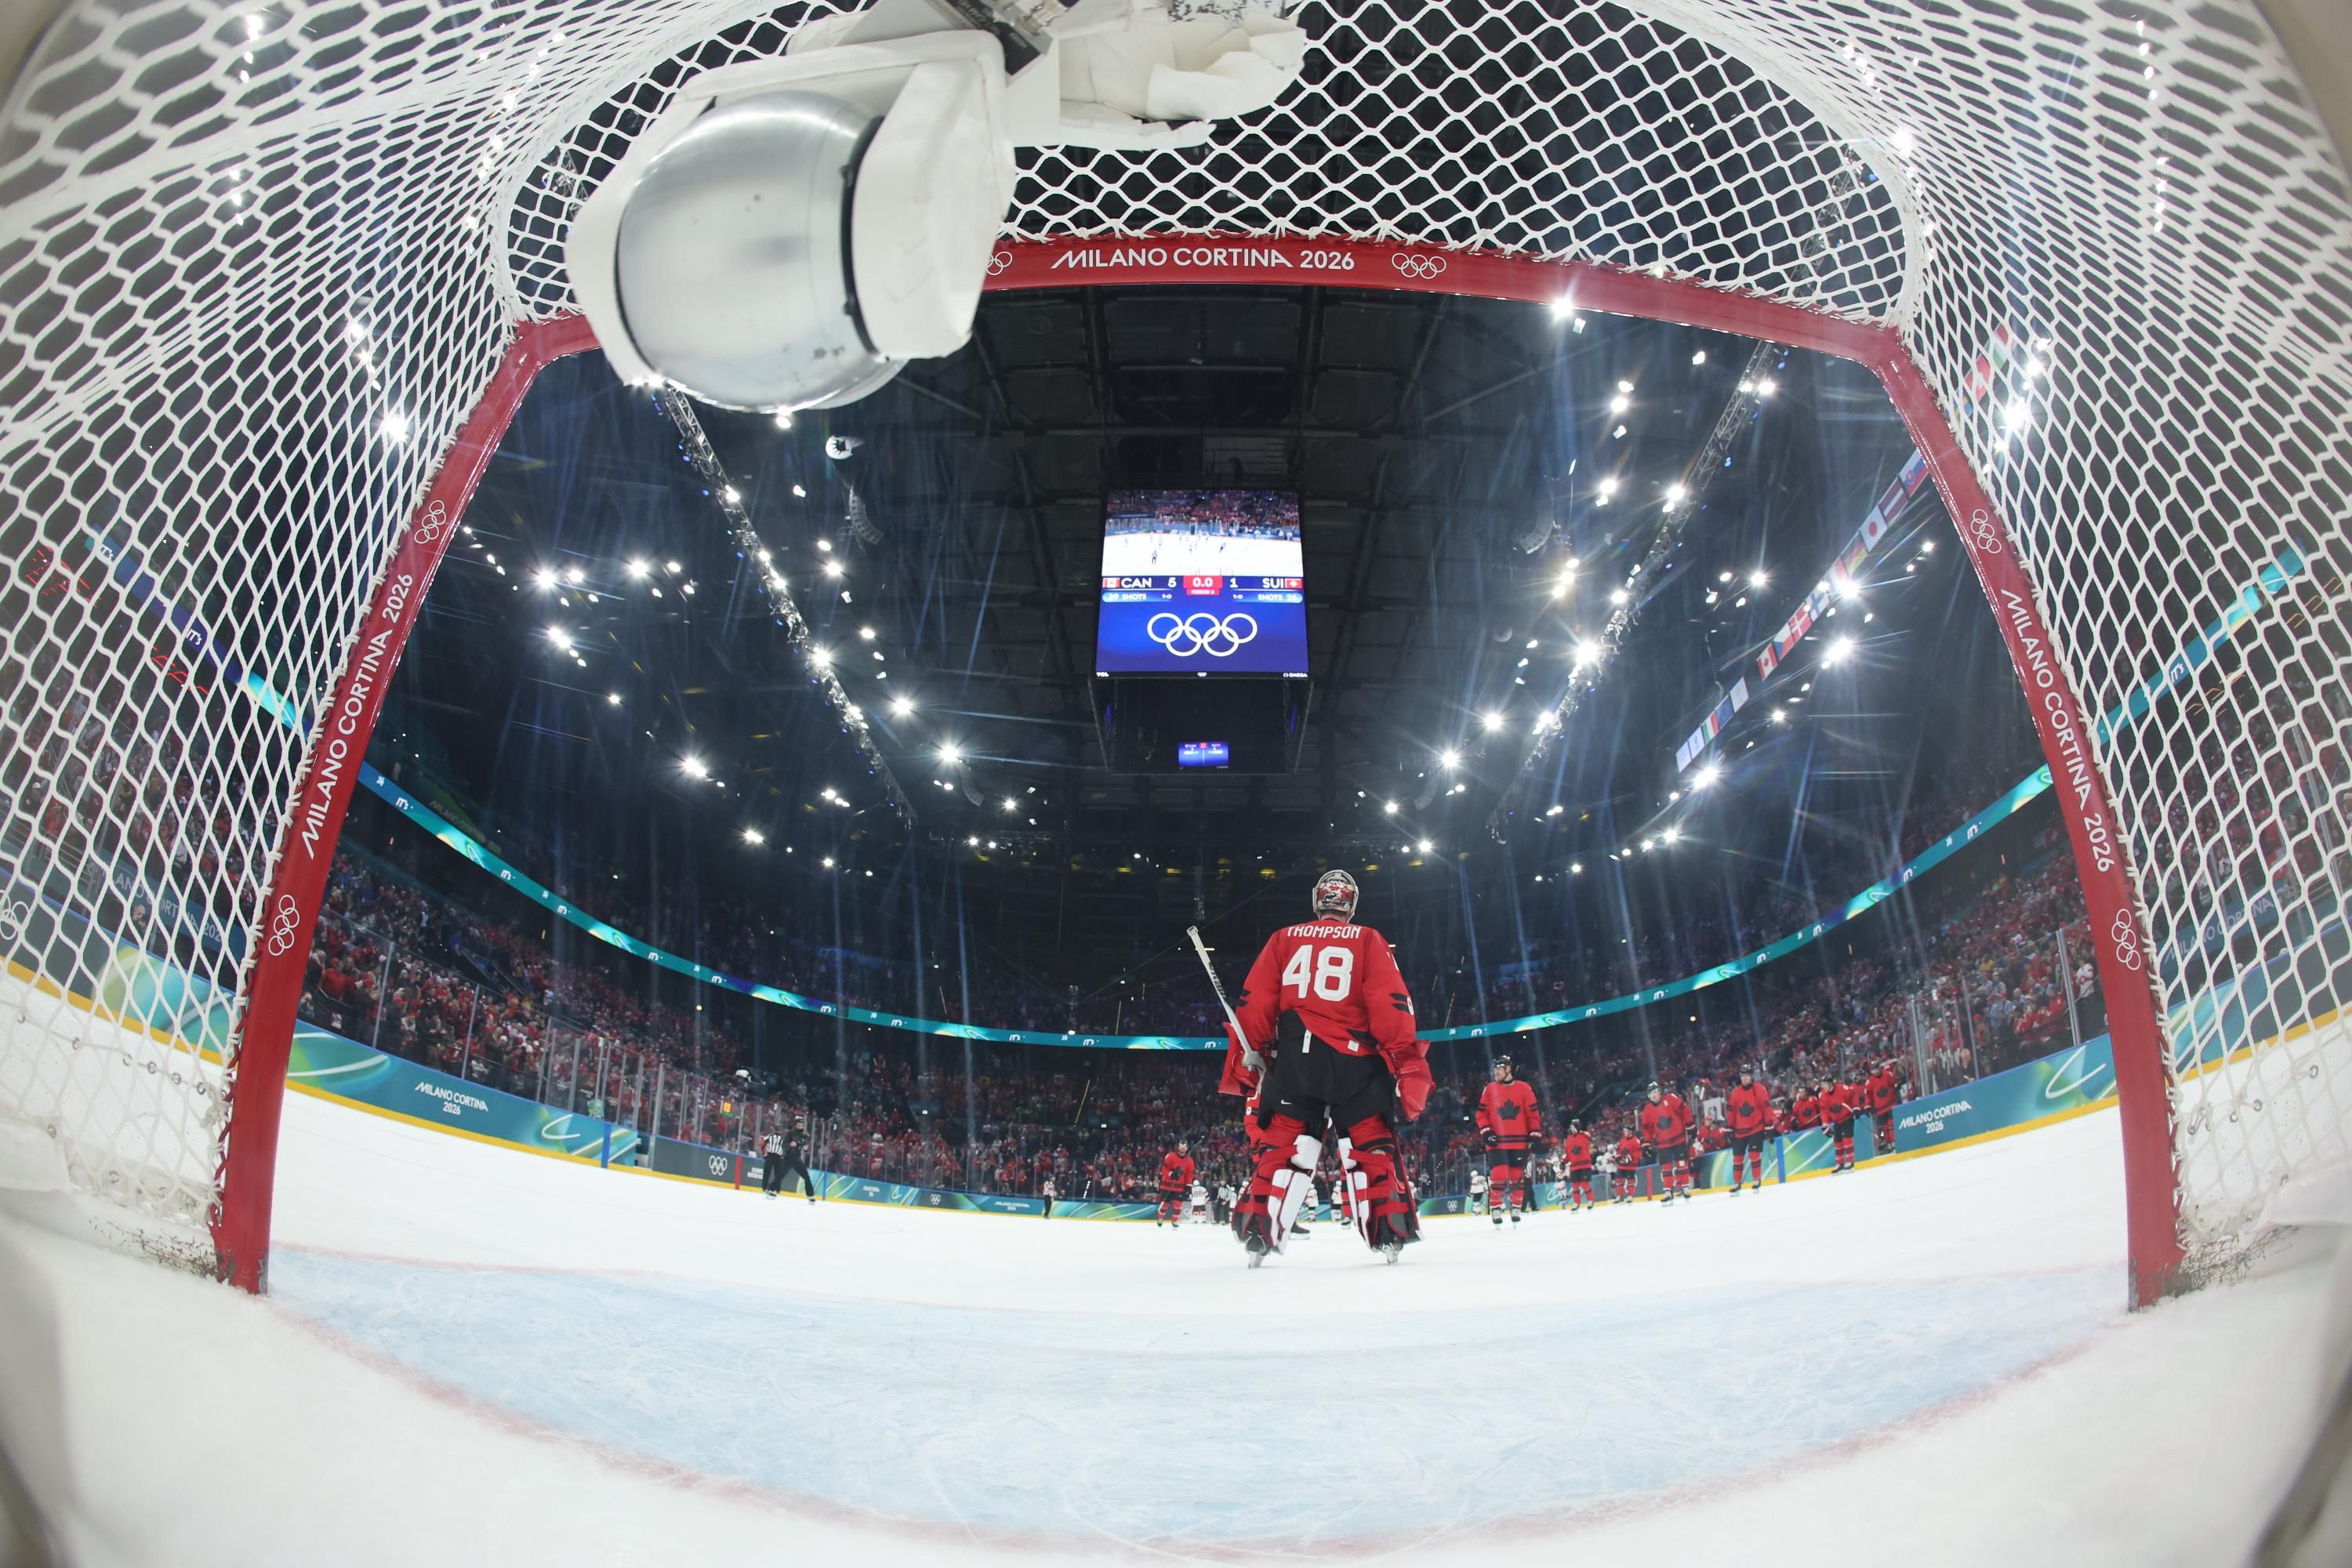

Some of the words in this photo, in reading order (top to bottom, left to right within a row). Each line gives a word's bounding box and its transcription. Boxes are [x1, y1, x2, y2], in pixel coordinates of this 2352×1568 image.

[1051, 248, 1167, 270] MILANO
[1173, 247, 1294, 268] CORTINA
[1299, 249, 1355, 270] 2026
[1120, 577, 1152, 588] CAN
[1167, 577, 1177, 588] 5
[1192, 577, 1213, 587] 0.0
[1229, 578, 1238, 588] 1
[1262, 577, 1284, 589] SUI
[1258, 593, 1283, 601] SHOTS
[301, 739, 348, 859] MILANO
[338, 629, 393, 735] CORTINA
[382, 574, 414, 623] 2026
[2001, 589, 2054, 688] MILANO
[2044, 691, 2089, 811] CORTINA
[2082, 813, 2115, 873] 2026
[1287, 925, 1362, 939] THOMPSON
[1282, 944, 1354, 1002] 48
[415, 1081, 452, 1101] MILANO
[453, 1093, 489, 1112] CORTINA
[442, 1102, 462, 1116] 2026
[1898, 1111, 1933, 1130] MILANO
[1933, 1099, 1973, 1120] CORTINA
[1926, 1120, 1944, 1134] 2026
